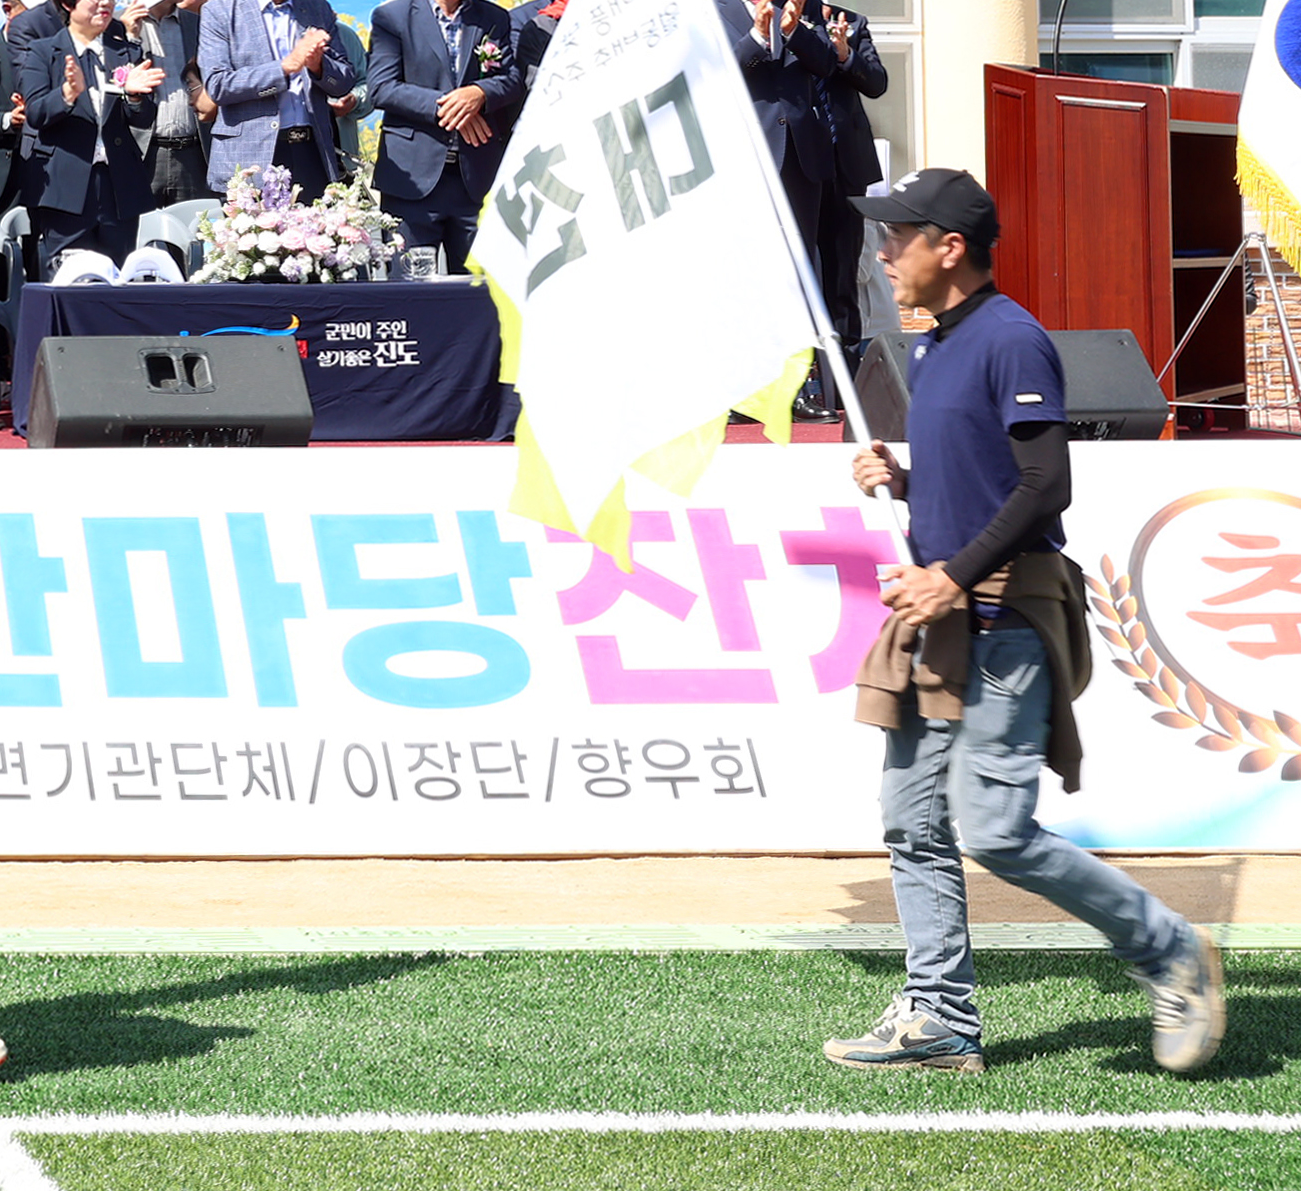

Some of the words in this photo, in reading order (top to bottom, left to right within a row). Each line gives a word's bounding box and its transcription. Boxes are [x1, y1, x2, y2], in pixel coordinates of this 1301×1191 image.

[325, 321, 372, 341] 군민이
[376, 320, 407, 340] 주인
[372, 340, 420, 368] 진도
